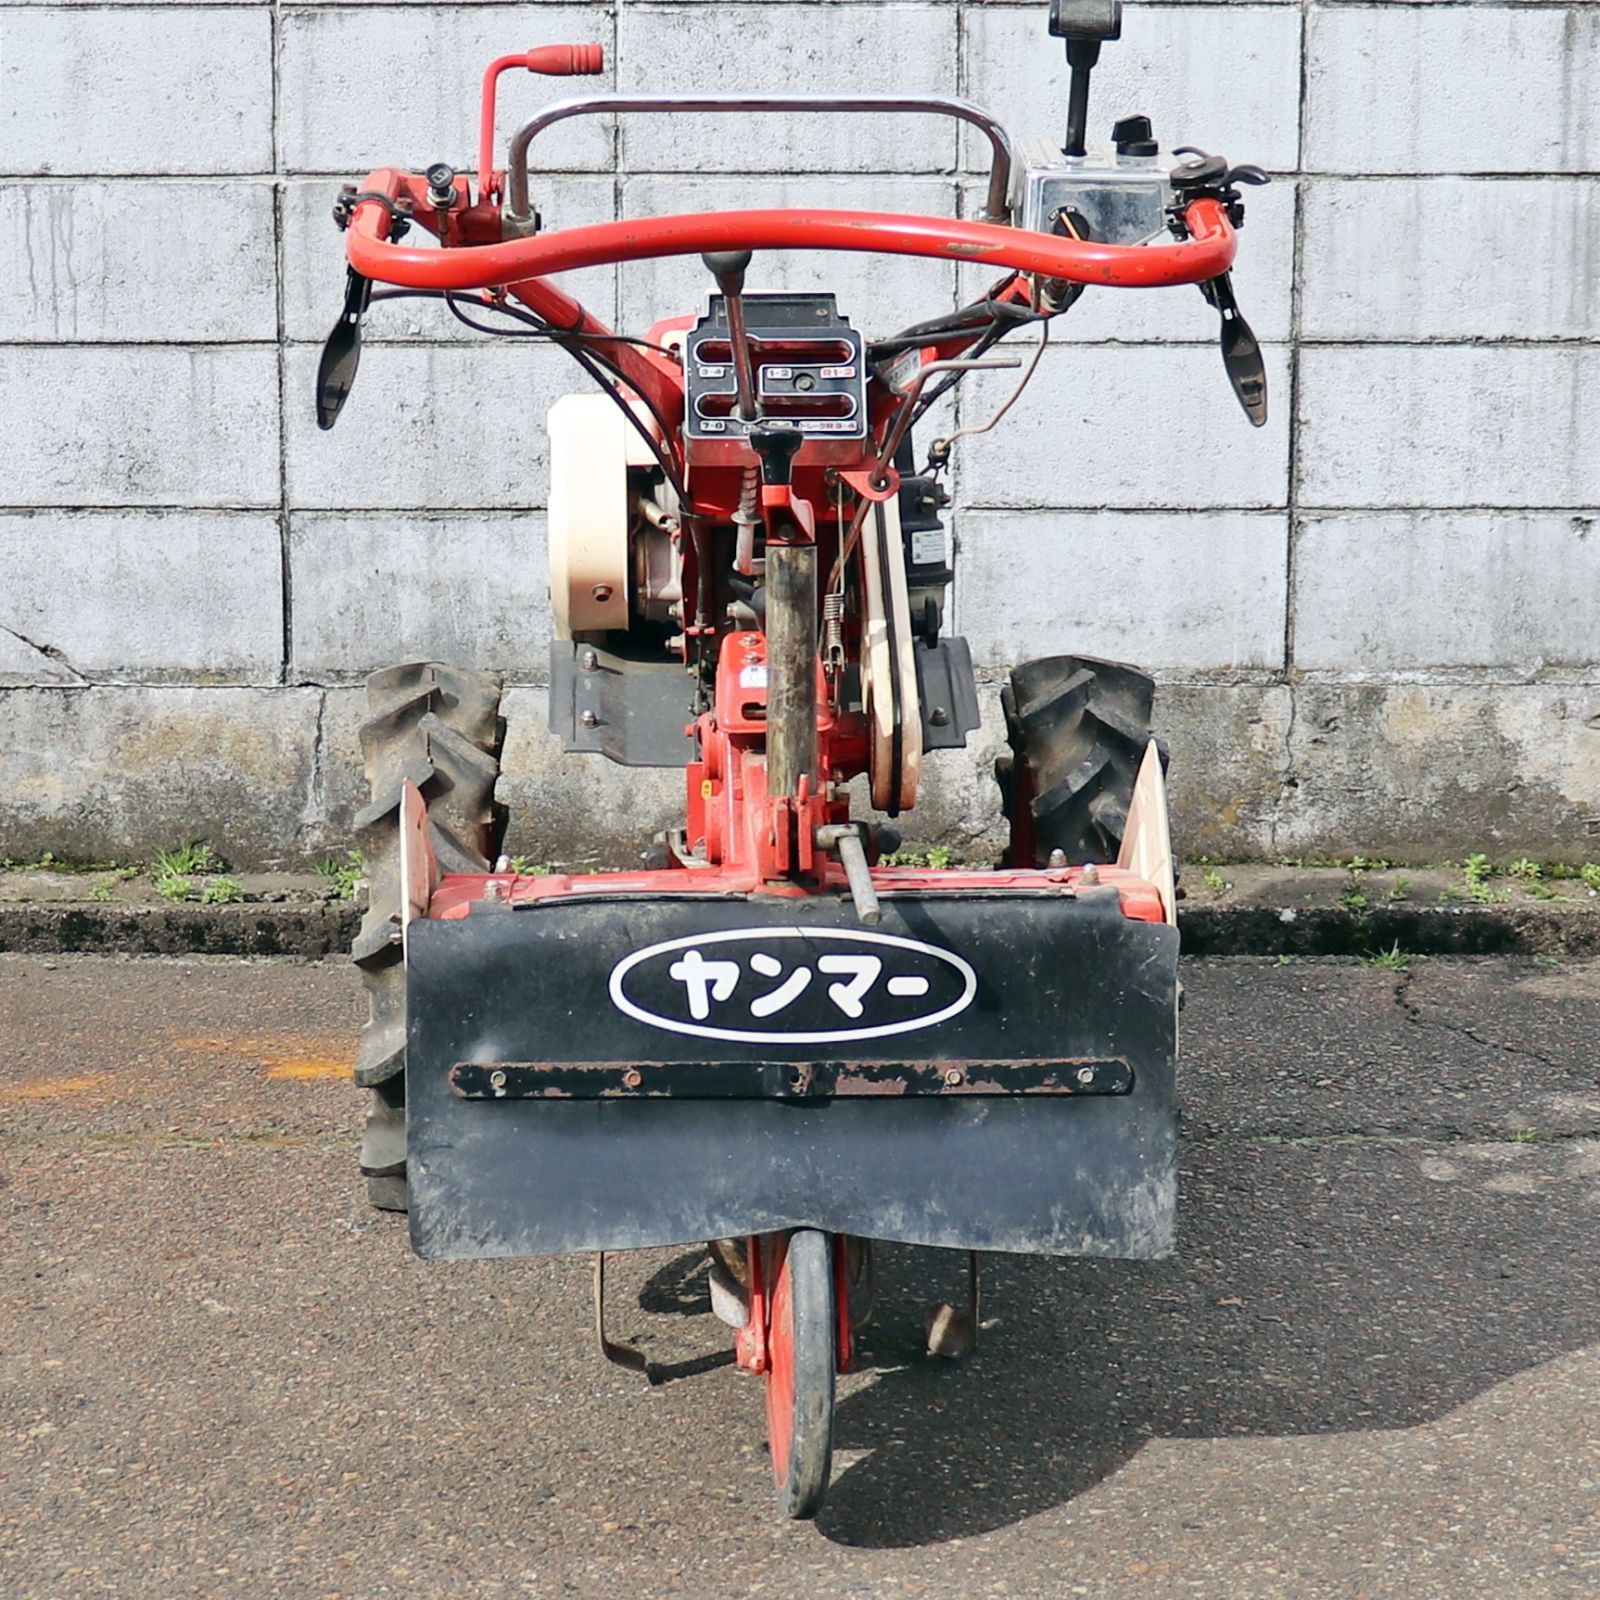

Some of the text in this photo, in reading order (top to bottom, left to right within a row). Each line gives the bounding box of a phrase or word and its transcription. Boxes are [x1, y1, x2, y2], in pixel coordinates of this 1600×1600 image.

[700, 368, 723, 376] 3-4
[769, 369, 790, 377] 1-2
[822, 368, 853, 377] R1-2
[668, 949, 930, 1021] ヤンマー
